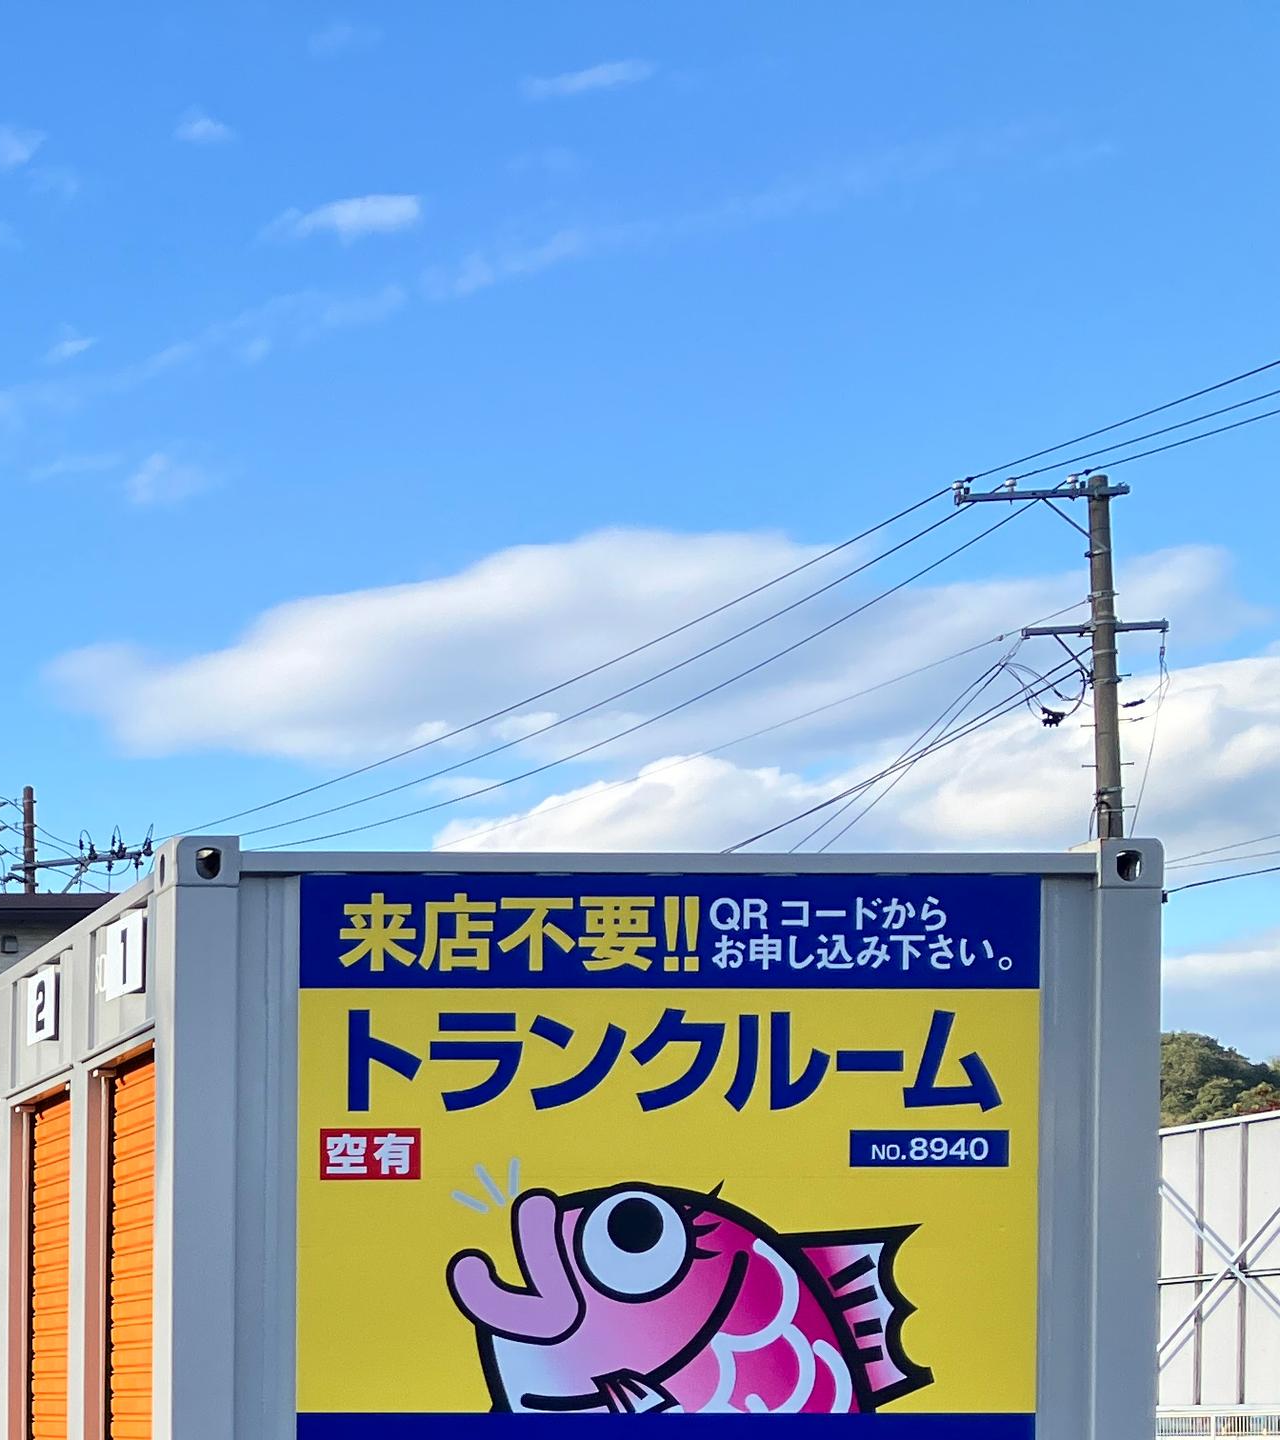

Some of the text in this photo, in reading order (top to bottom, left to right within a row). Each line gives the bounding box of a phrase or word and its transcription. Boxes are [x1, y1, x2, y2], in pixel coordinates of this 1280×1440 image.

[709, 896, 947, 931] QR コードから
[120, 927, 128, 985] 1
[712, 934, 1013, 971] お申し込み下さい。
[35, 979, 46, 1033] 2
[348, 1008, 1002, 1112] トランクルーム
[326, 1132, 415, 1175] 空有
